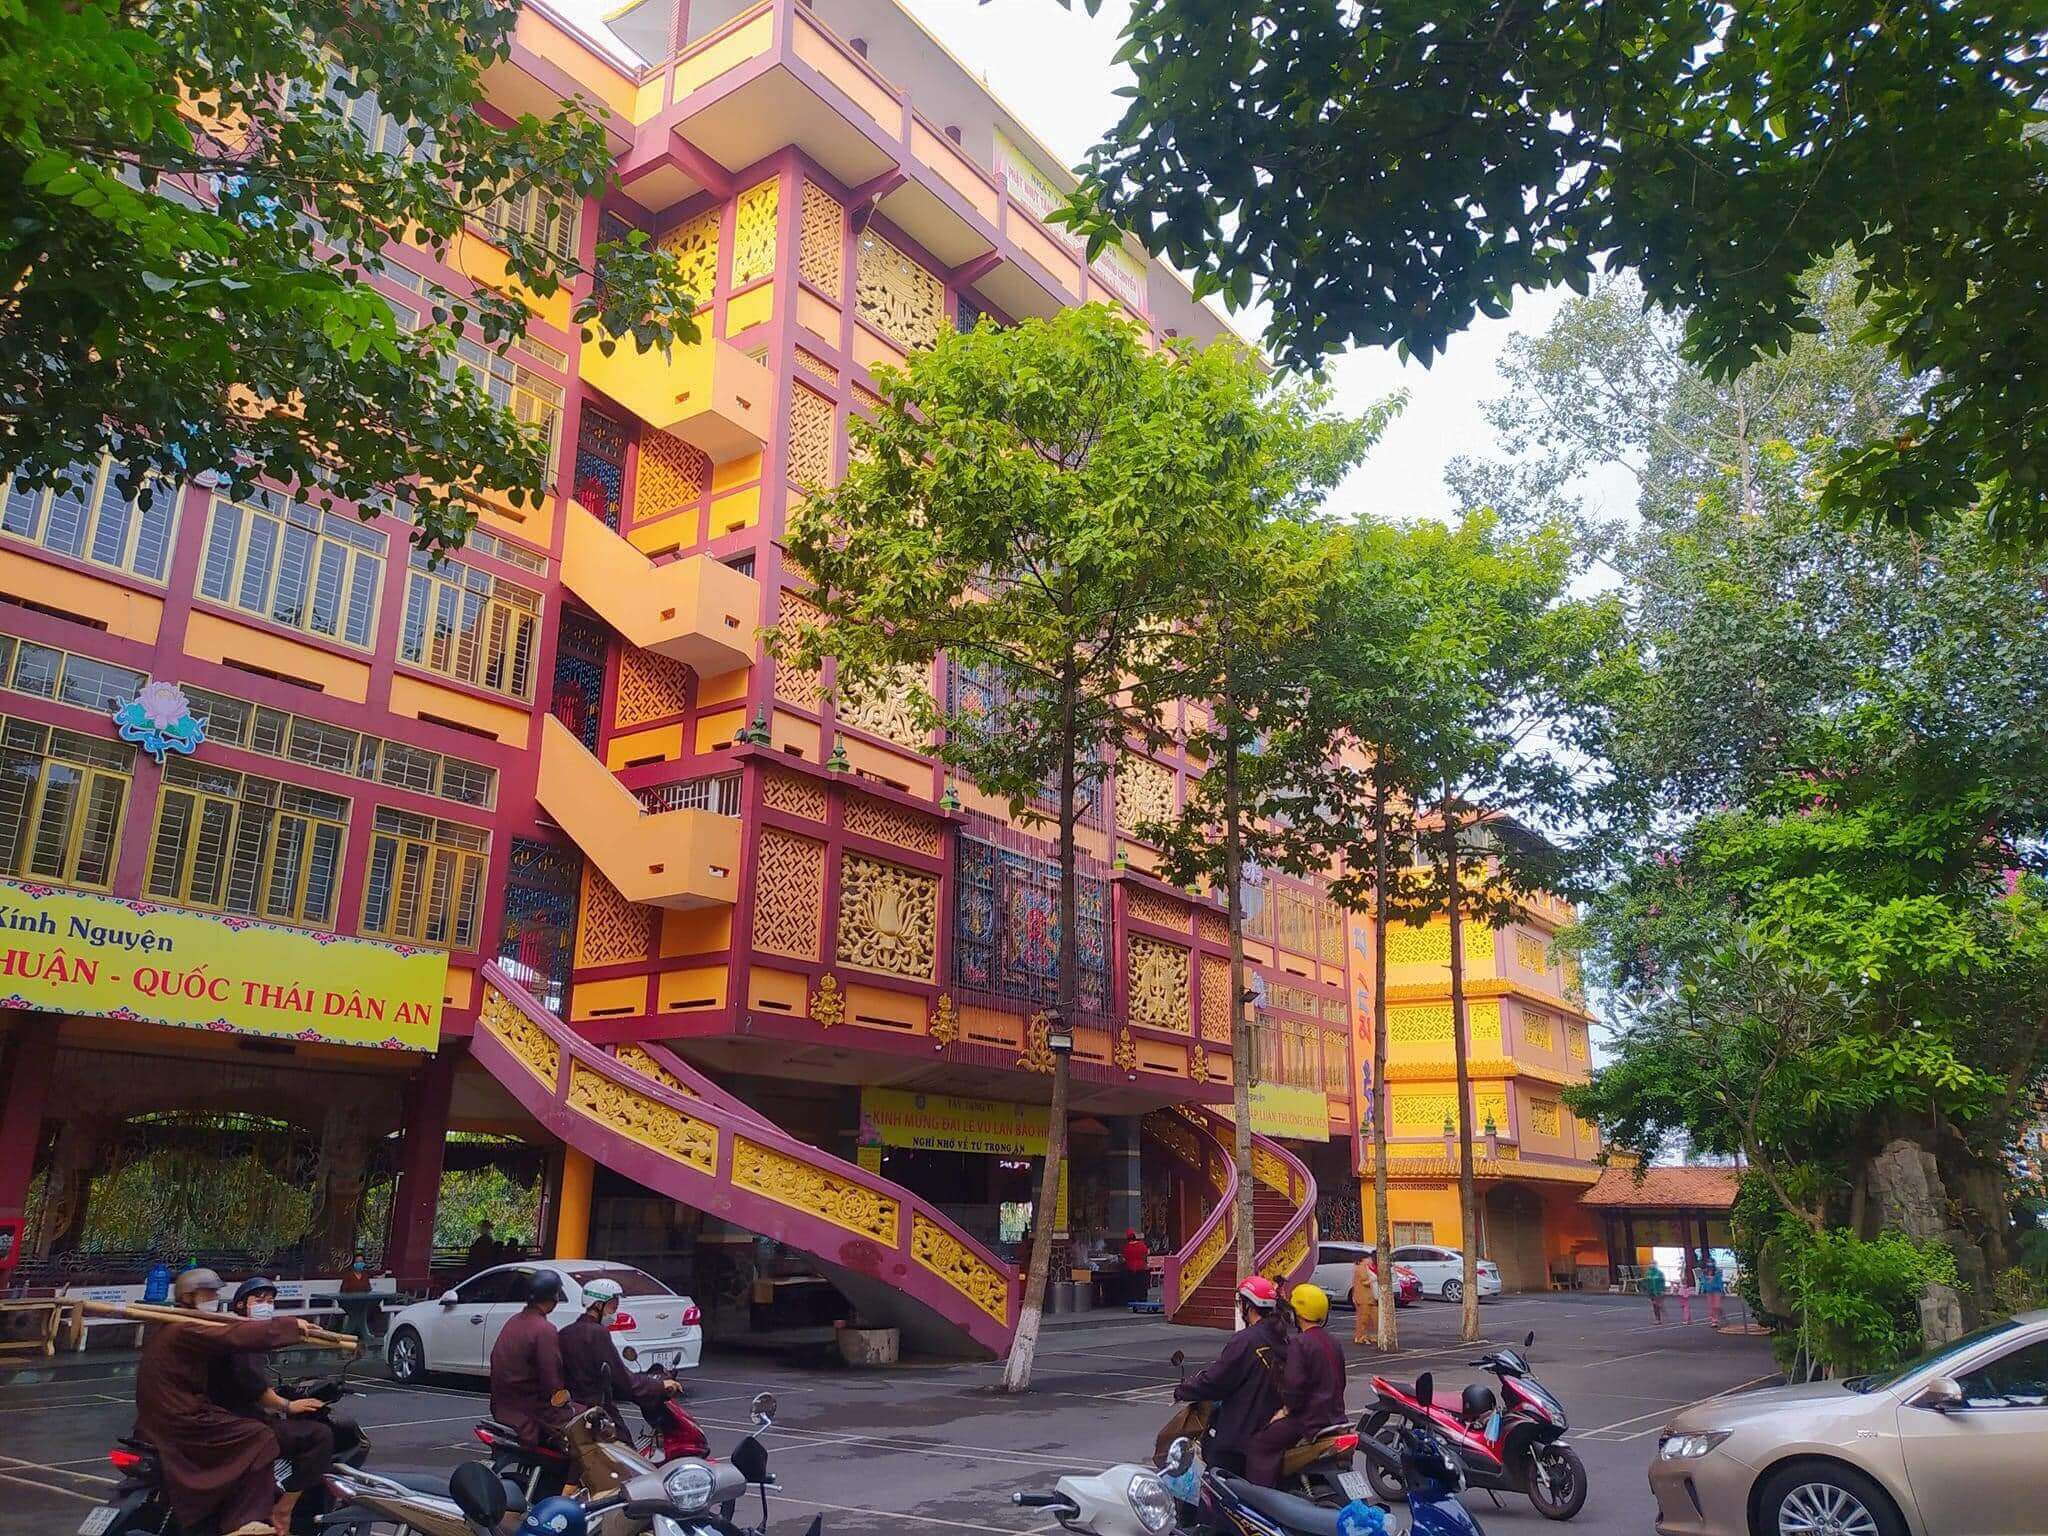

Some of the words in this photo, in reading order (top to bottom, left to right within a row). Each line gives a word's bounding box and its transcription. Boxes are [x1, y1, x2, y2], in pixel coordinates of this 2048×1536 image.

[68, 916, 174, 954] Nguyện
[132, 963, 231, 1001] QUỐC
[242, 981, 315, 1014] THÁI
[323, 988, 386, 1021] DÂN
[394, 1002, 433, 1026] AN
